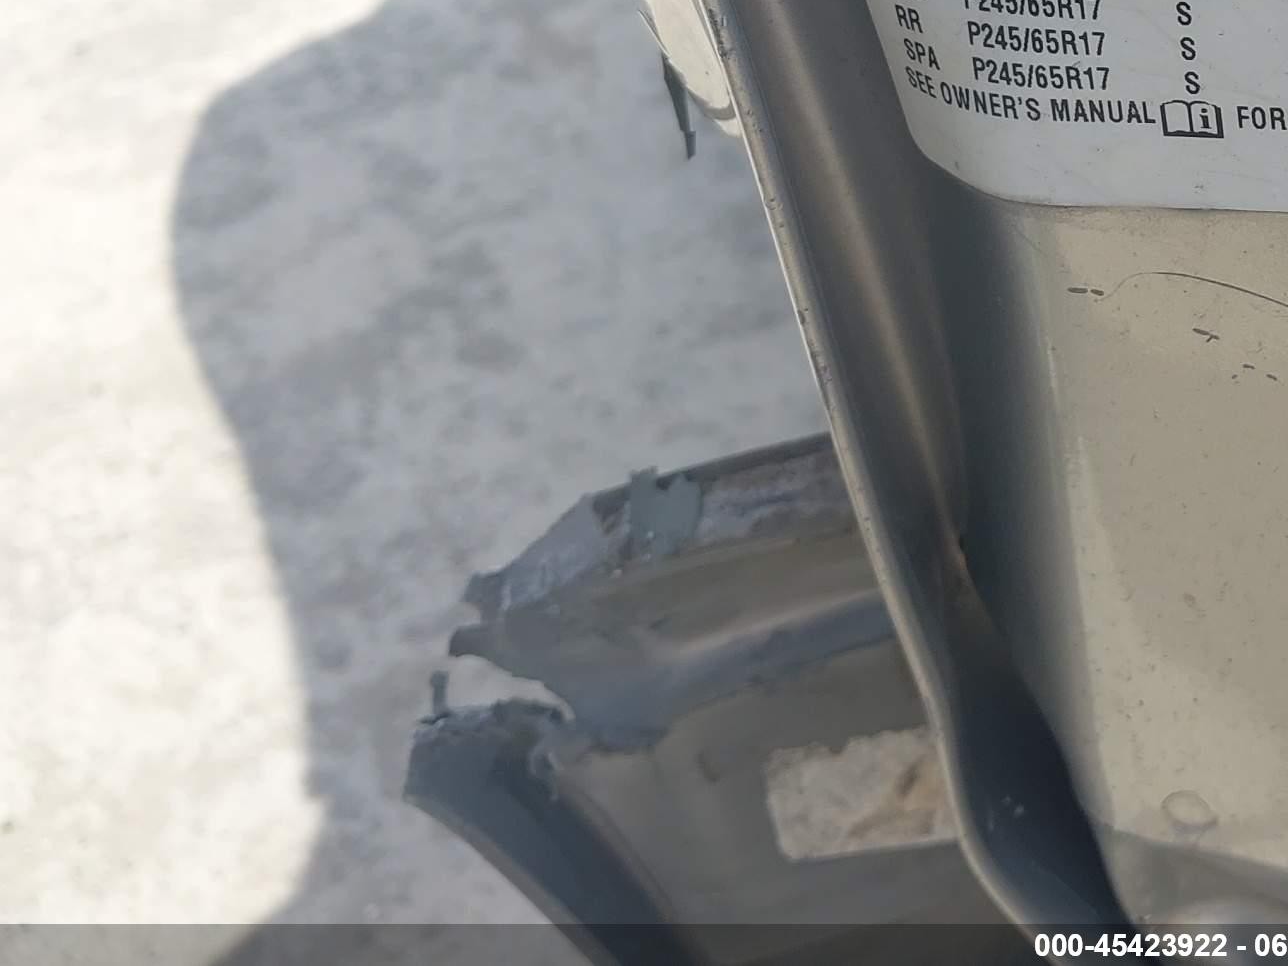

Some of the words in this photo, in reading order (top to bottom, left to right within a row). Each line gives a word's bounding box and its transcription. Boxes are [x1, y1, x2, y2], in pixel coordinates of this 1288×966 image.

[895, 4, 923, 33] RR
[967, 21, 1105, 56] P245/65R17
[1180, 37, 1196, 60] S
[1176, 2, 1192, 26] S
[904, 38, 940, 70] SPA
[972, 57, 1109, 90] P245/65R17
[1184, 71, 1201, 94] S
[906, 66, 937, 98] SEE
[940, 82, 1041, 121] OWNER'S
[1050, 99, 1156, 124] MANUAL
[1237, 106, 1287, 130] FOR
